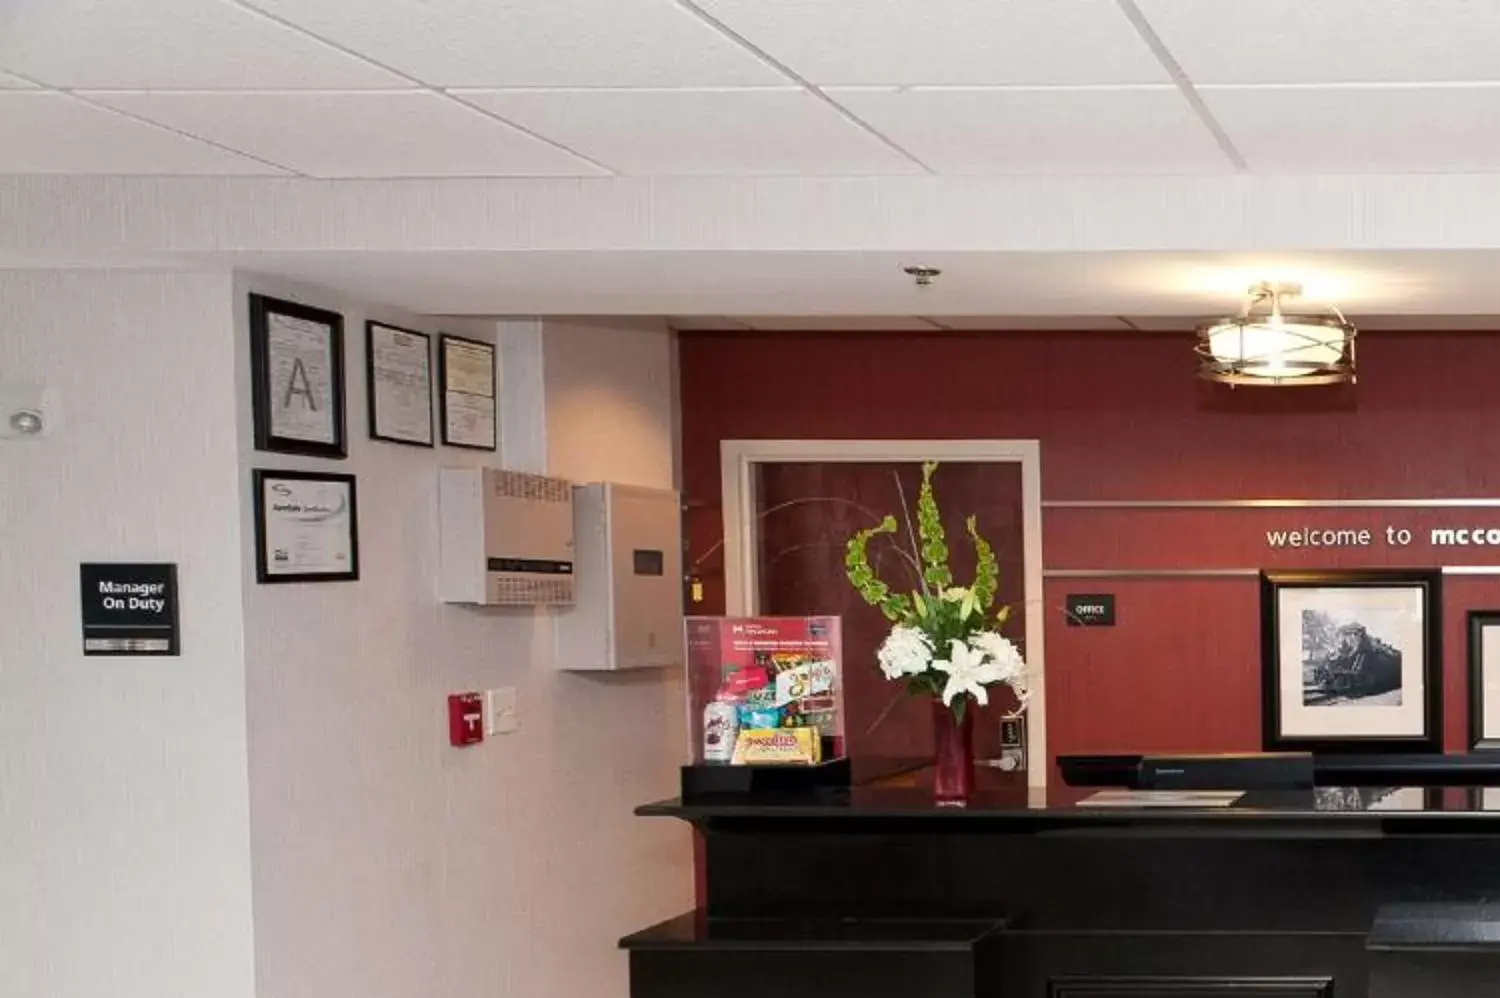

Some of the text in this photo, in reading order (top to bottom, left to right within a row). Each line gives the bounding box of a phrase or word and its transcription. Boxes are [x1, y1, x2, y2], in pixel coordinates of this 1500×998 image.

[284, 357, 318, 412] A
[1266, 527, 1371, 546] welcome
[1386, 525, 1412, 545] to
[99, 581, 165, 597] Manager
[103, 597, 165, 613] On Duty
[1075, 605, 1105, 615] OFFICE
